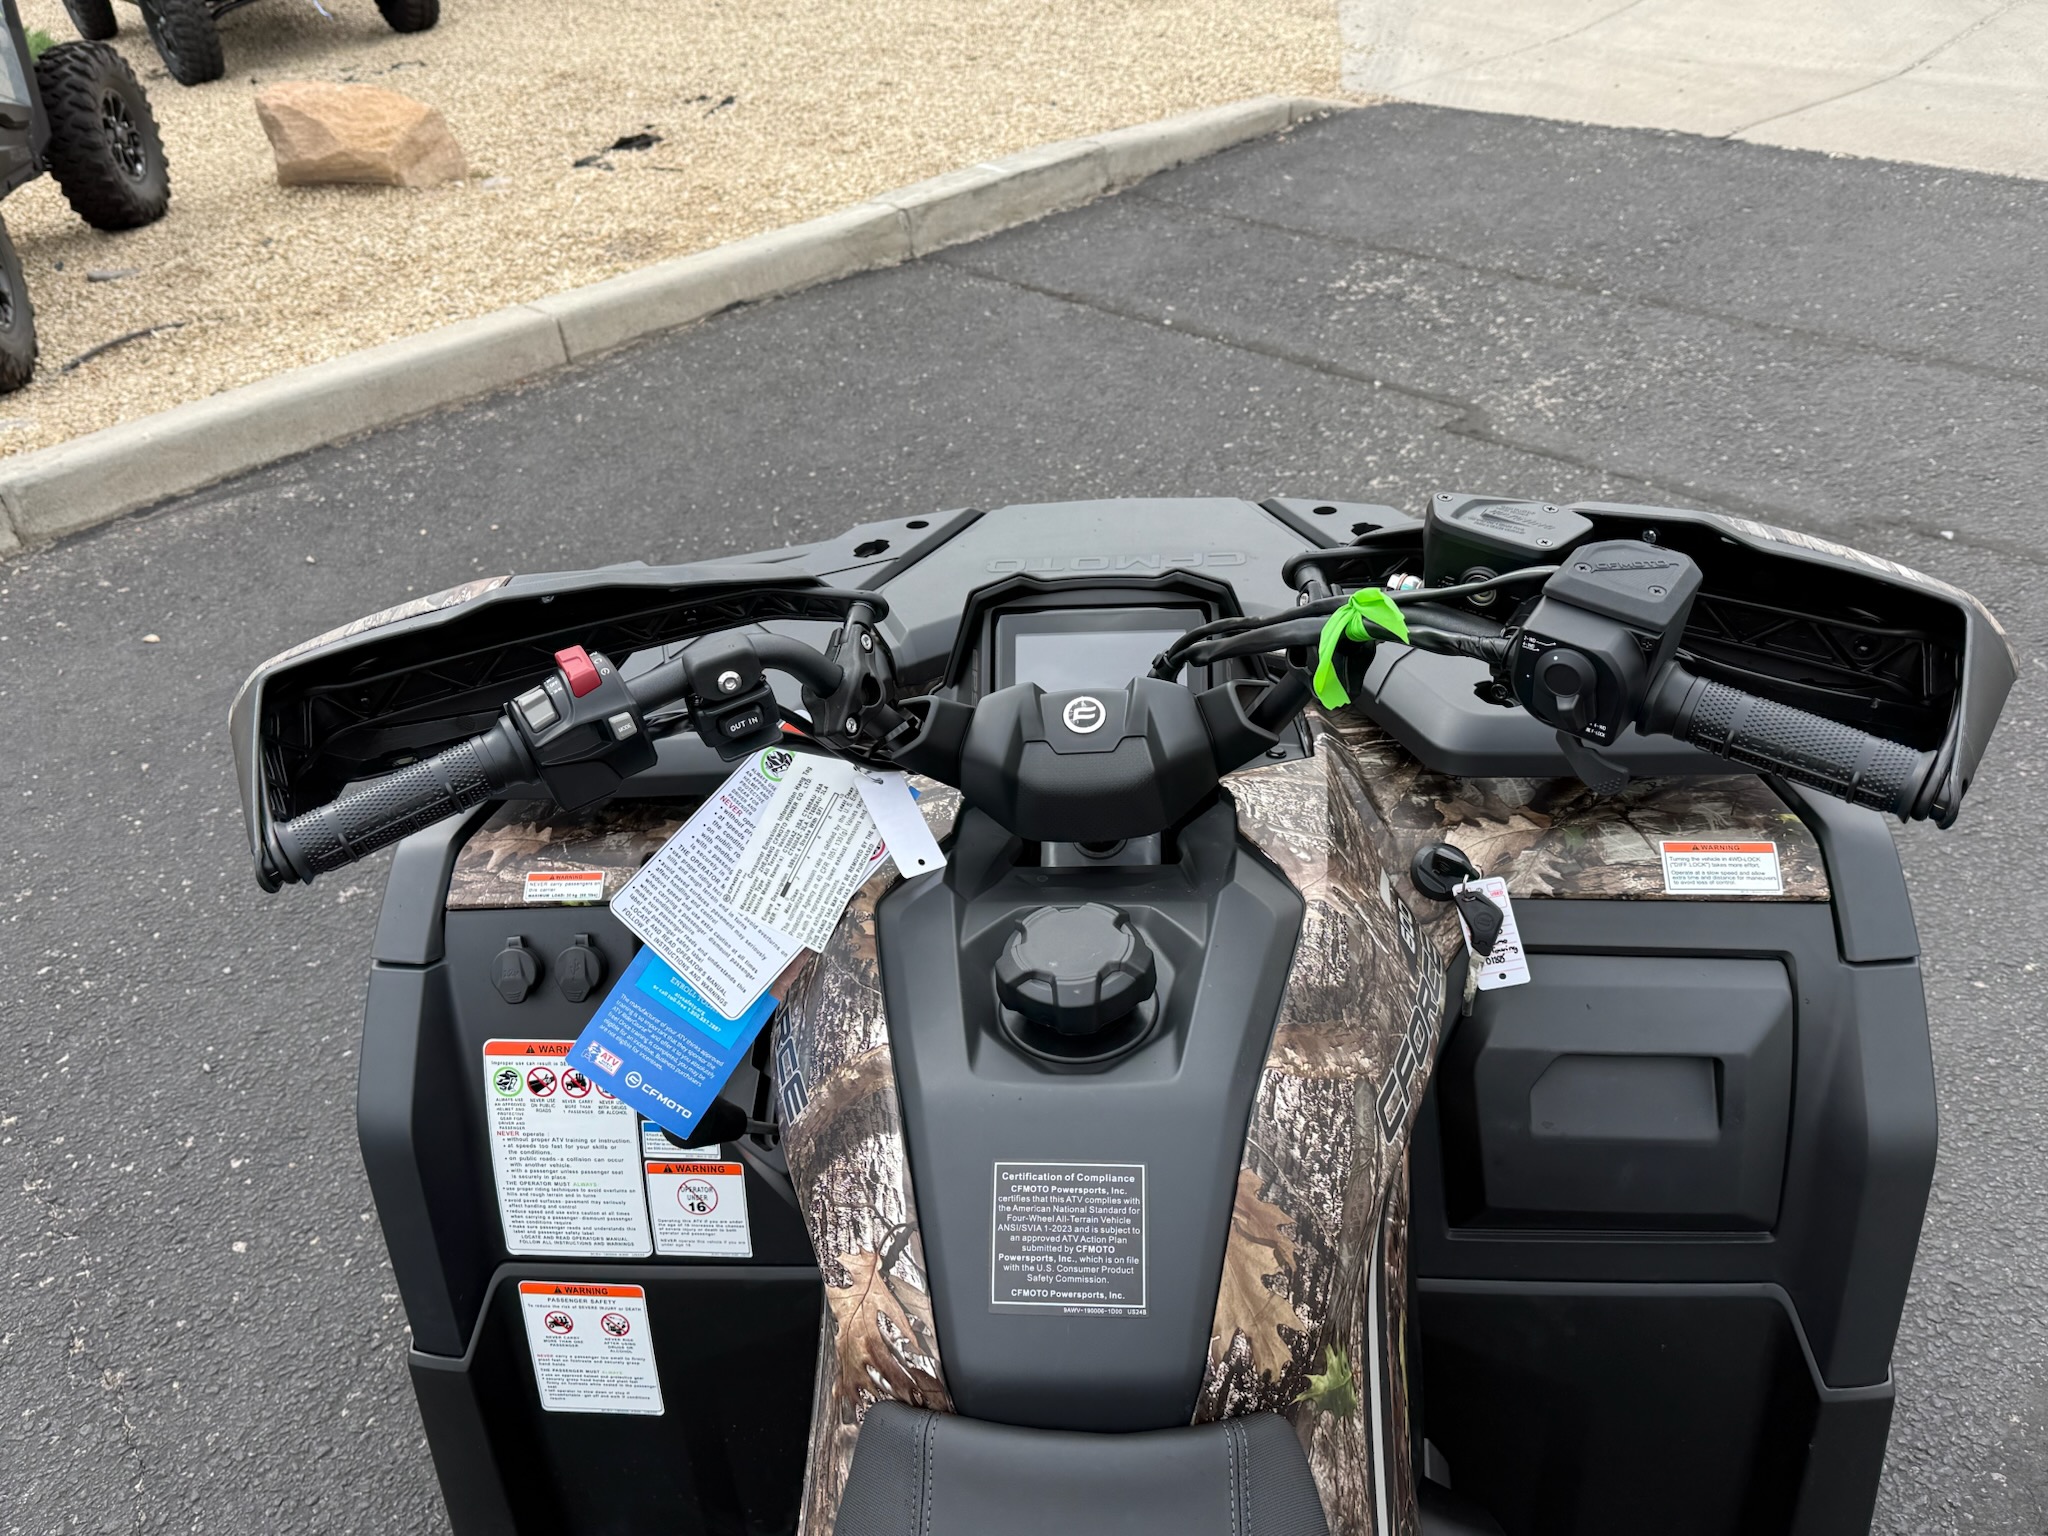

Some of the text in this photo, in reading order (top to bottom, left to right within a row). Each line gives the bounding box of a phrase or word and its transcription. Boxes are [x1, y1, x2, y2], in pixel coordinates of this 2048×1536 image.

[986, 552, 1247, 573] CFMOTO
[1596, 561, 1668, 570] CFMOTO
[618, 722, 632, 732] MODE
[730, 716, 758, 732] OUT IN
[718, 794, 743, 817] NEVER
[676, 843, 721, 884] THE OPERATOR
[628, 904, 650, 925] LOCATE
[649, 922, 662, 935] AND
[660, 933, 676, 949] READ
[620, 907, 728, 1007] FOLLOW ALL INSTRUCTIONS AND WARNINGS
[1376, 922, 1444, 1145] CFORCE
[600, 1051, 619, 1067] ATV
[640, 1082, 692, 1119] CFMOTO
[1002, 1172, 1135, 1183] Certification of Compliance
[1011, 1185, 1127, 1196] CFMOTO Powersports, Inc.
[998, 1195, 1140, 1205] certifies that this ATV complies with
[689, 1202, 706, 1212] 16
[998, 1204, 1140, 1215] the American National Standard for
[1007, 1214, 1131, 1224] Four-Wheel All-Terrain Vehicle
[998, 1224, 1140, 1234] ANSI/SVIA 1-2023 and is subject to
[1010, 1235, 1127, 1244] an approved ATV Action Plan
[1022, 1245, 1115, 1254] submitted by CFMOTO
[998, 1254, 1056, 1263] Powersports,
[1079, 1256, 1103, 1264] which
[1105, 1256, 1112, 1264] is
[1114, 1256, 1124, 1265] on
[1126, 1257, 1139, 1265] file
[1056, 1265, 1098, 1273] Consumer
[1101, 1266, 1134, 1274] Product
[1027, 1274, 1109, 1284] Safety Commission.
[565, 1286, 608, 1295] WARNING
[1011, 1289, 1125, 1300] CFMOTO Powersports, Inc.
